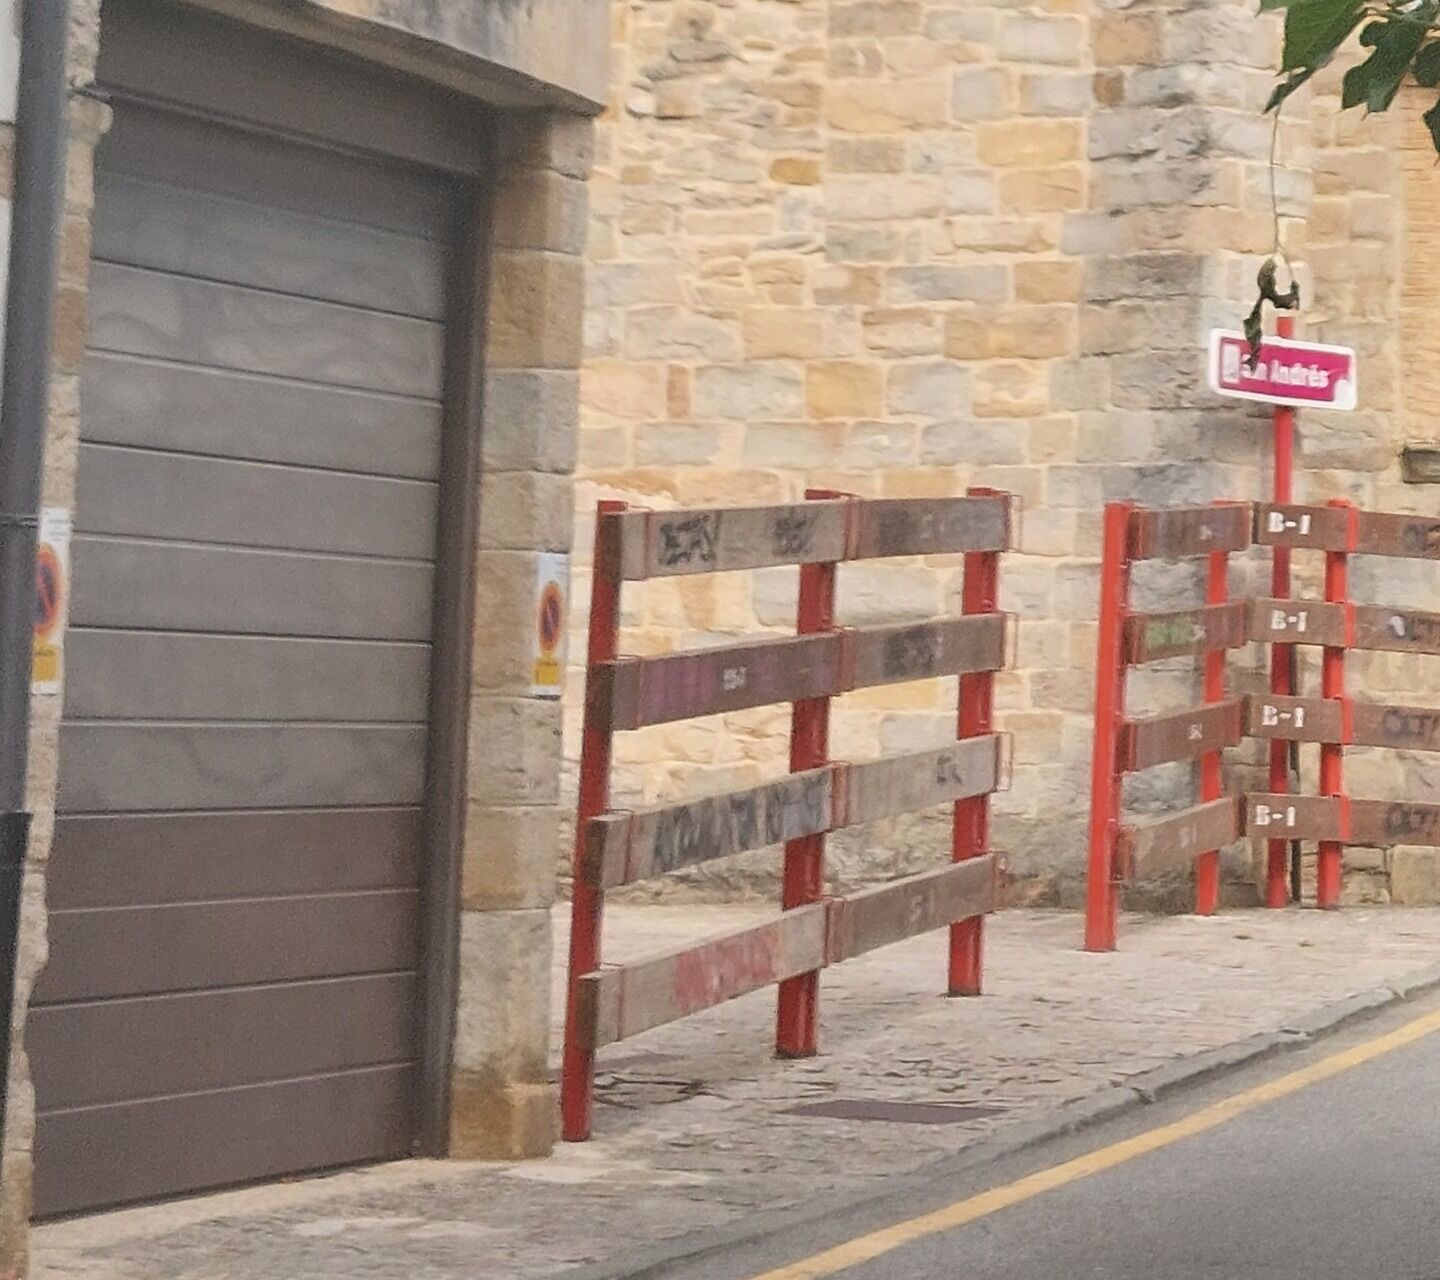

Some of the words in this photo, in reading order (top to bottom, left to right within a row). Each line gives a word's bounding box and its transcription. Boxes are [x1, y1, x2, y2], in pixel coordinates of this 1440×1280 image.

[1266, 510, 1312, 536] B-1
[1269, 608, 1308, 633] B-1
[1261, 703, 1305, 729] B-1
[1253, 804, 1296, 828] B-1
